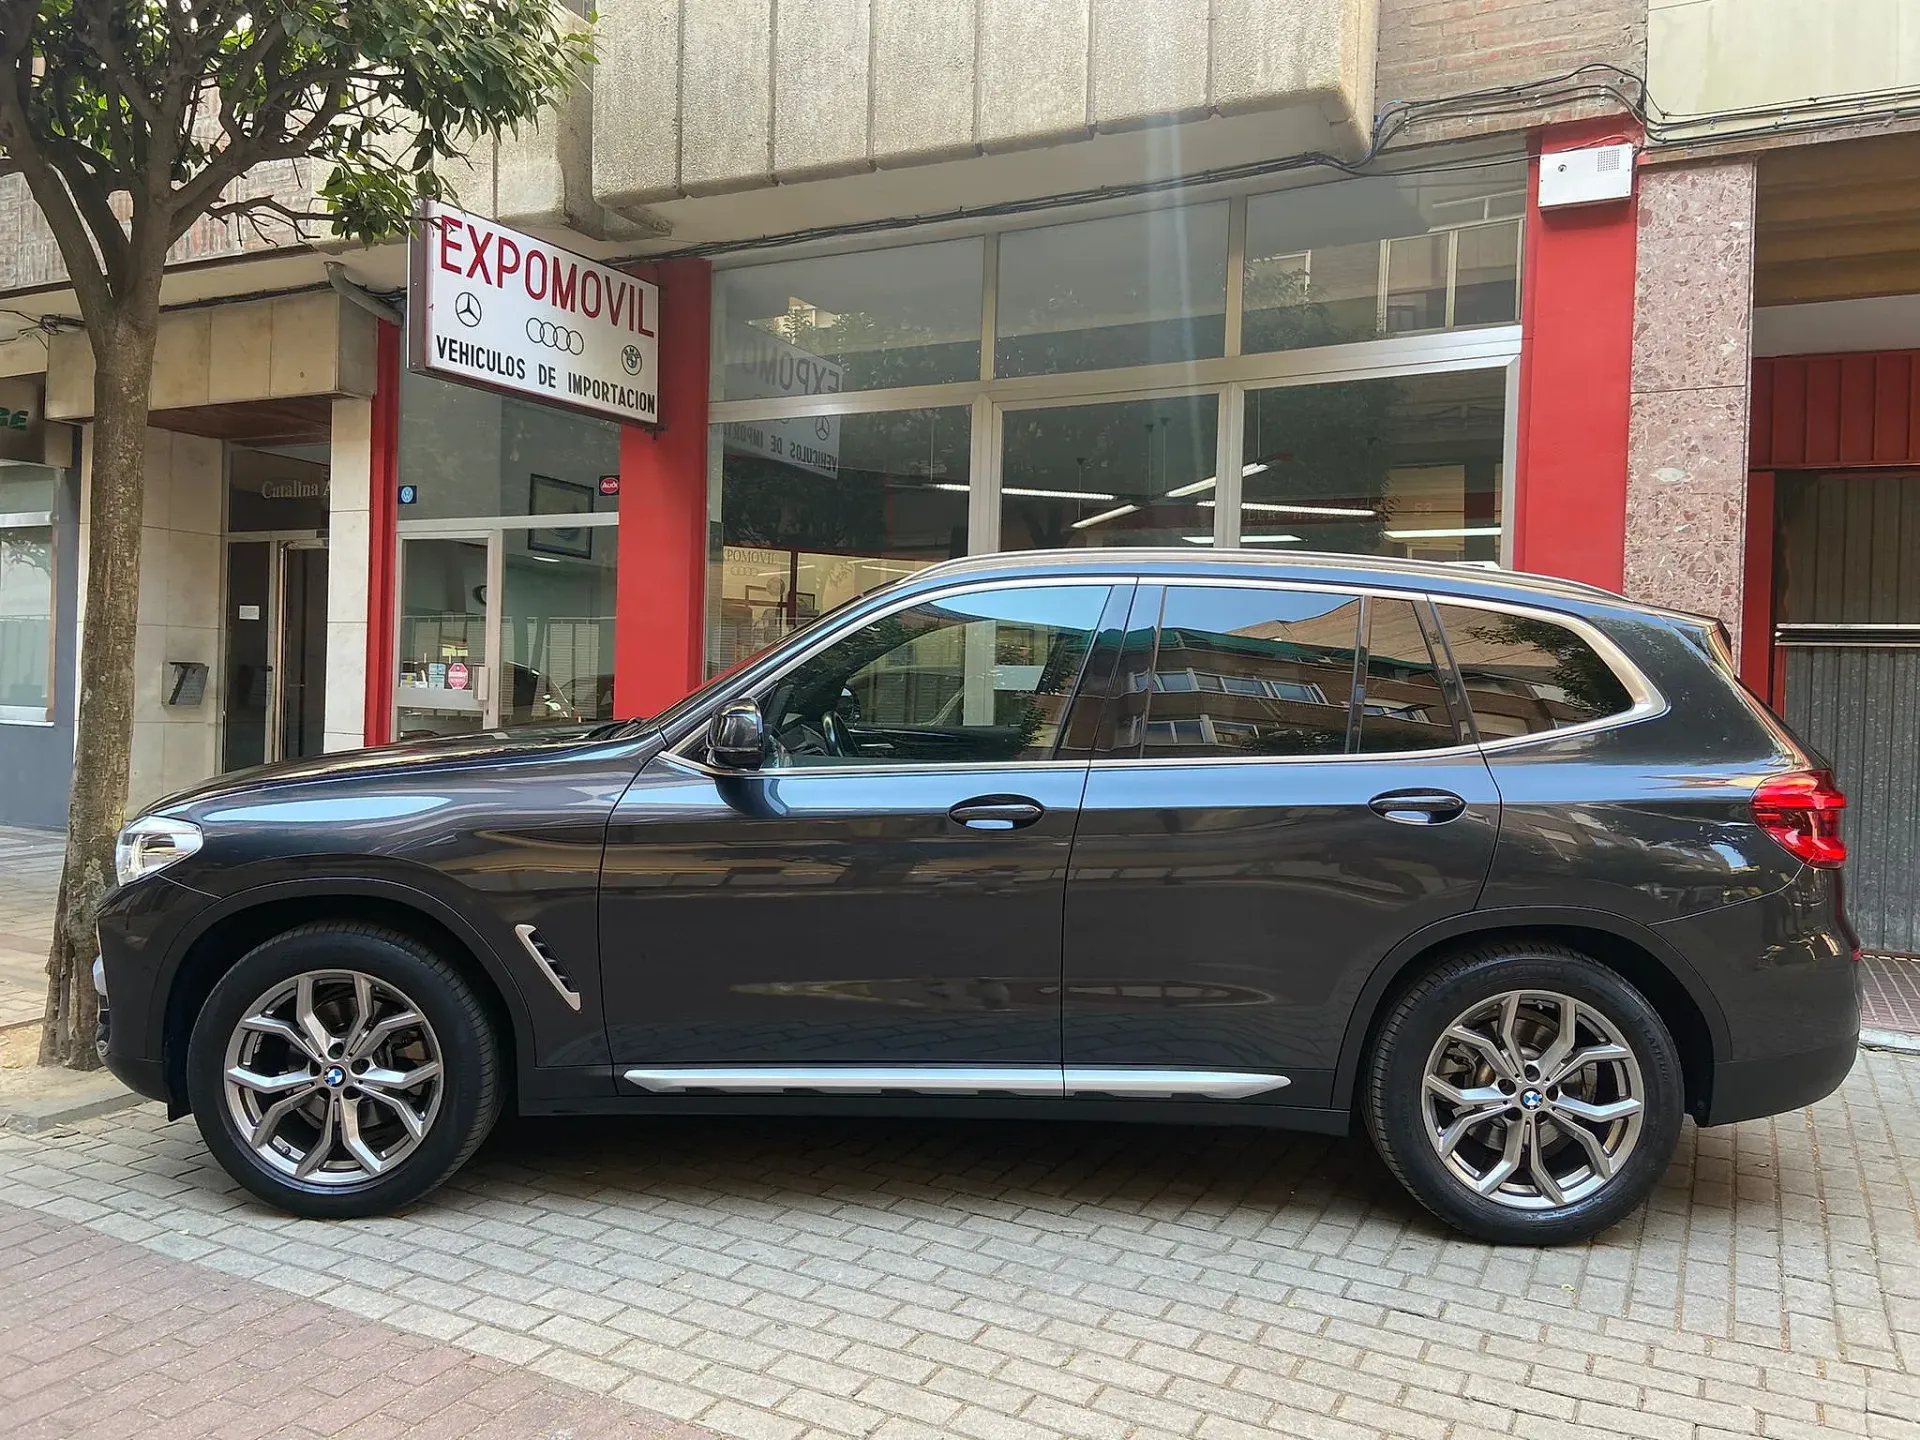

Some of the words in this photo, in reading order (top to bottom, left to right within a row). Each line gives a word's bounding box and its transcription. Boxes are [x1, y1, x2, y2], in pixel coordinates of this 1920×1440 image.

[440, 214, 655, 338] EXPOMOVIL
[436, 334, 526, 380] VEHICULOS
[538, 363, 556, 388] DE
[568, 371, 655, 414] IMPORTACION
[261, 481, 318, 498] Catalina
